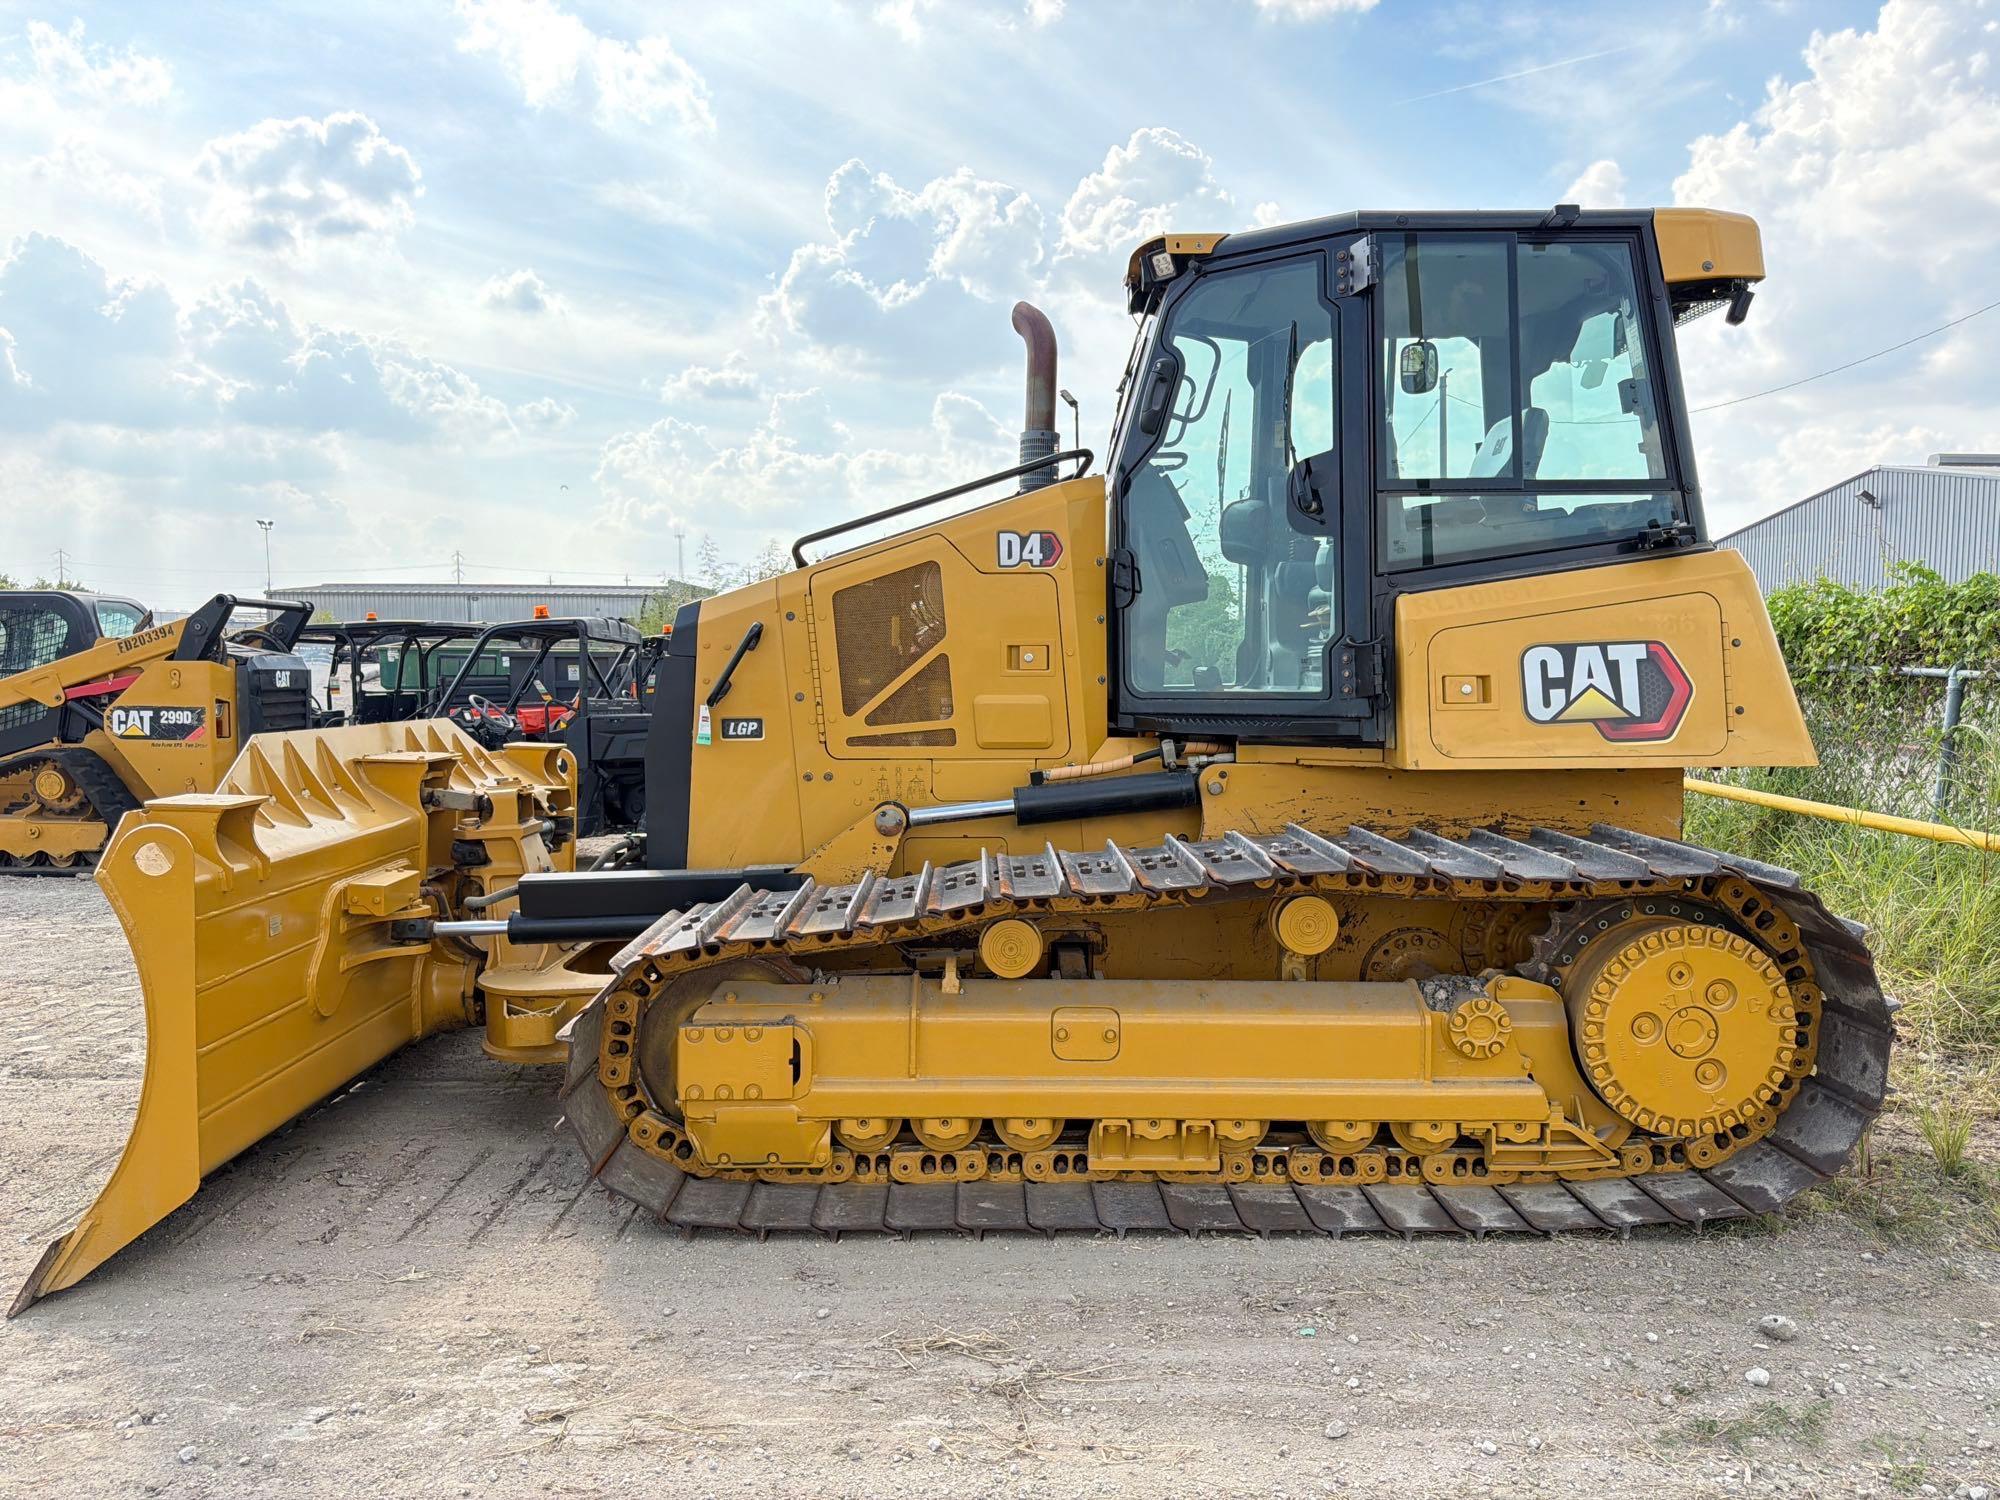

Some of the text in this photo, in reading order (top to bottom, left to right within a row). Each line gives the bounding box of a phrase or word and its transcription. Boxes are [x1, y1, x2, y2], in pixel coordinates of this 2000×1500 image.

[999, 533, 1043, 565] D4
[275, 670, 290, 687] CAT
[1523, 643, 1648, 721] CAT
[112, 710, 153, 736] CAT
[728, 722, 758, 735] LGP
